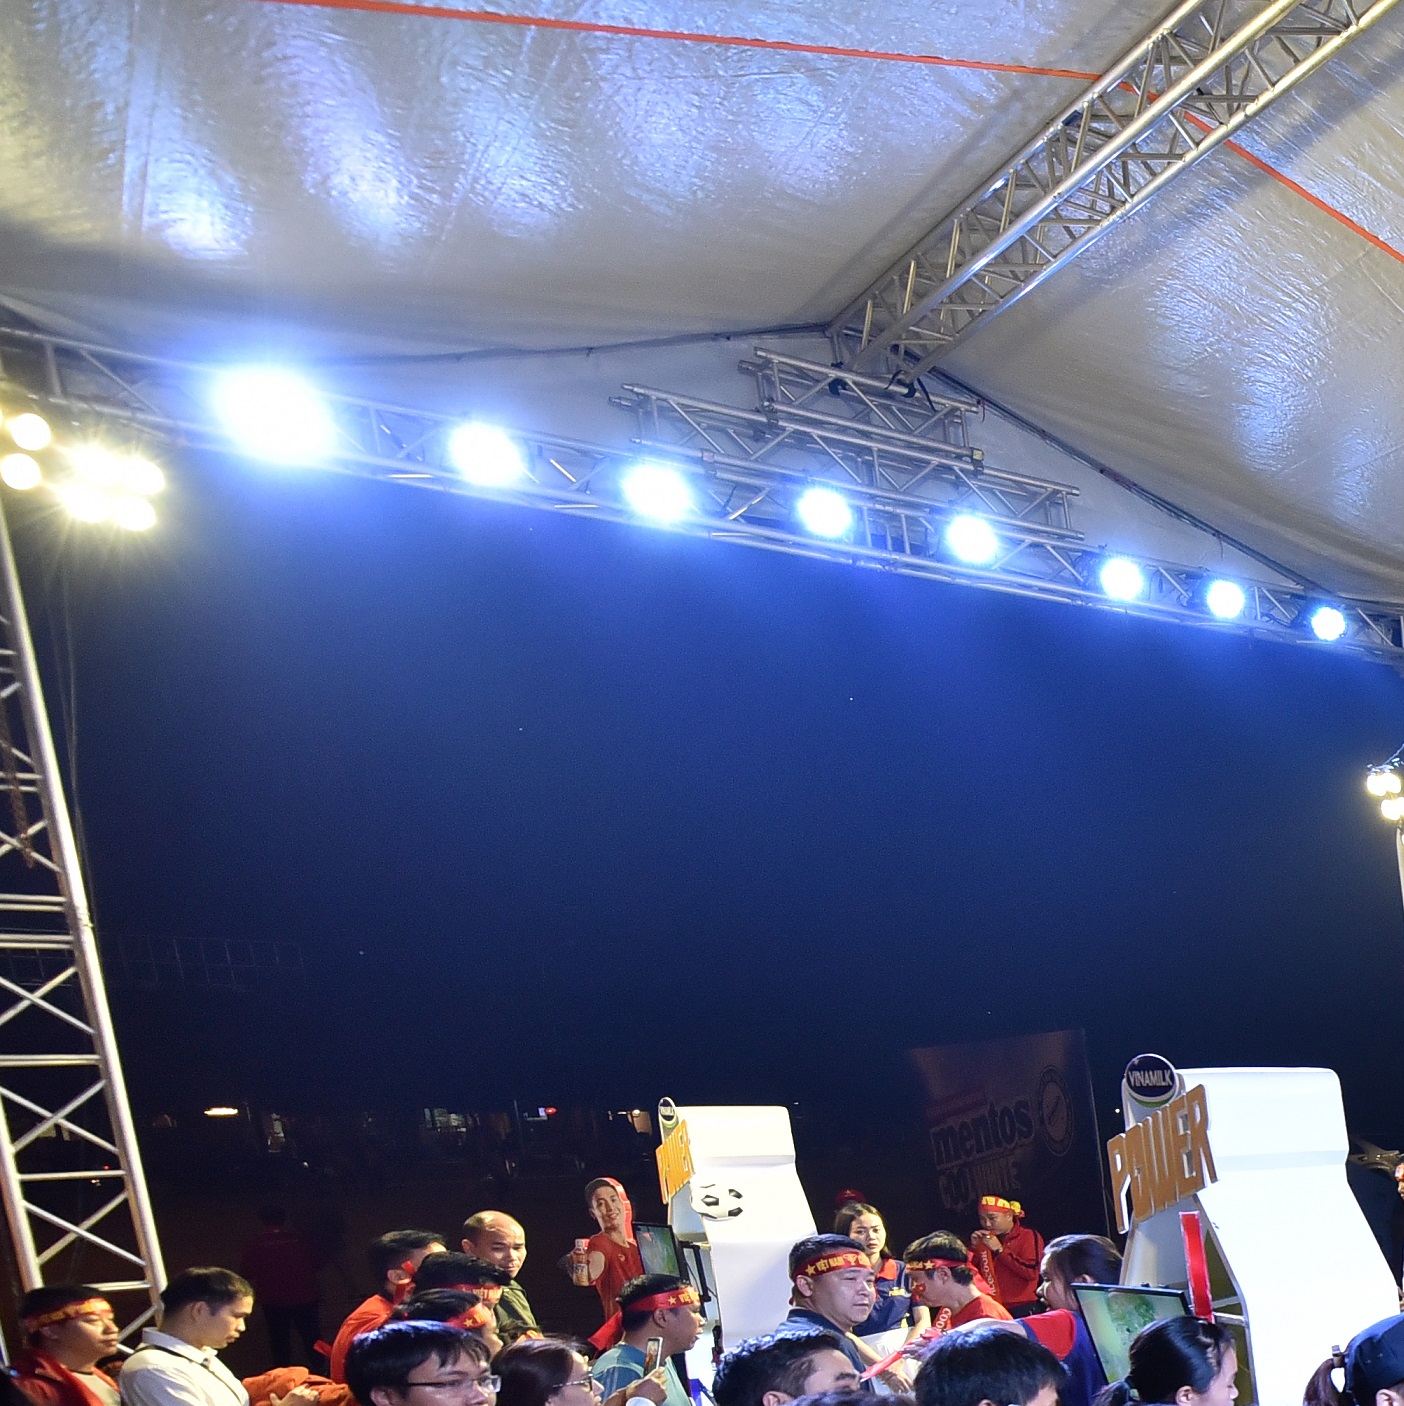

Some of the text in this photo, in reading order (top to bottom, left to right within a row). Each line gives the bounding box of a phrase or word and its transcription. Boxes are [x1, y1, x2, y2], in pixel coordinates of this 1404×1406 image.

[1128, 1069, 1173, 1087] VINAMILK
[931, 1099, 1035, 1169] mentos
[1107, 1084, 1220, 1234] POWER
